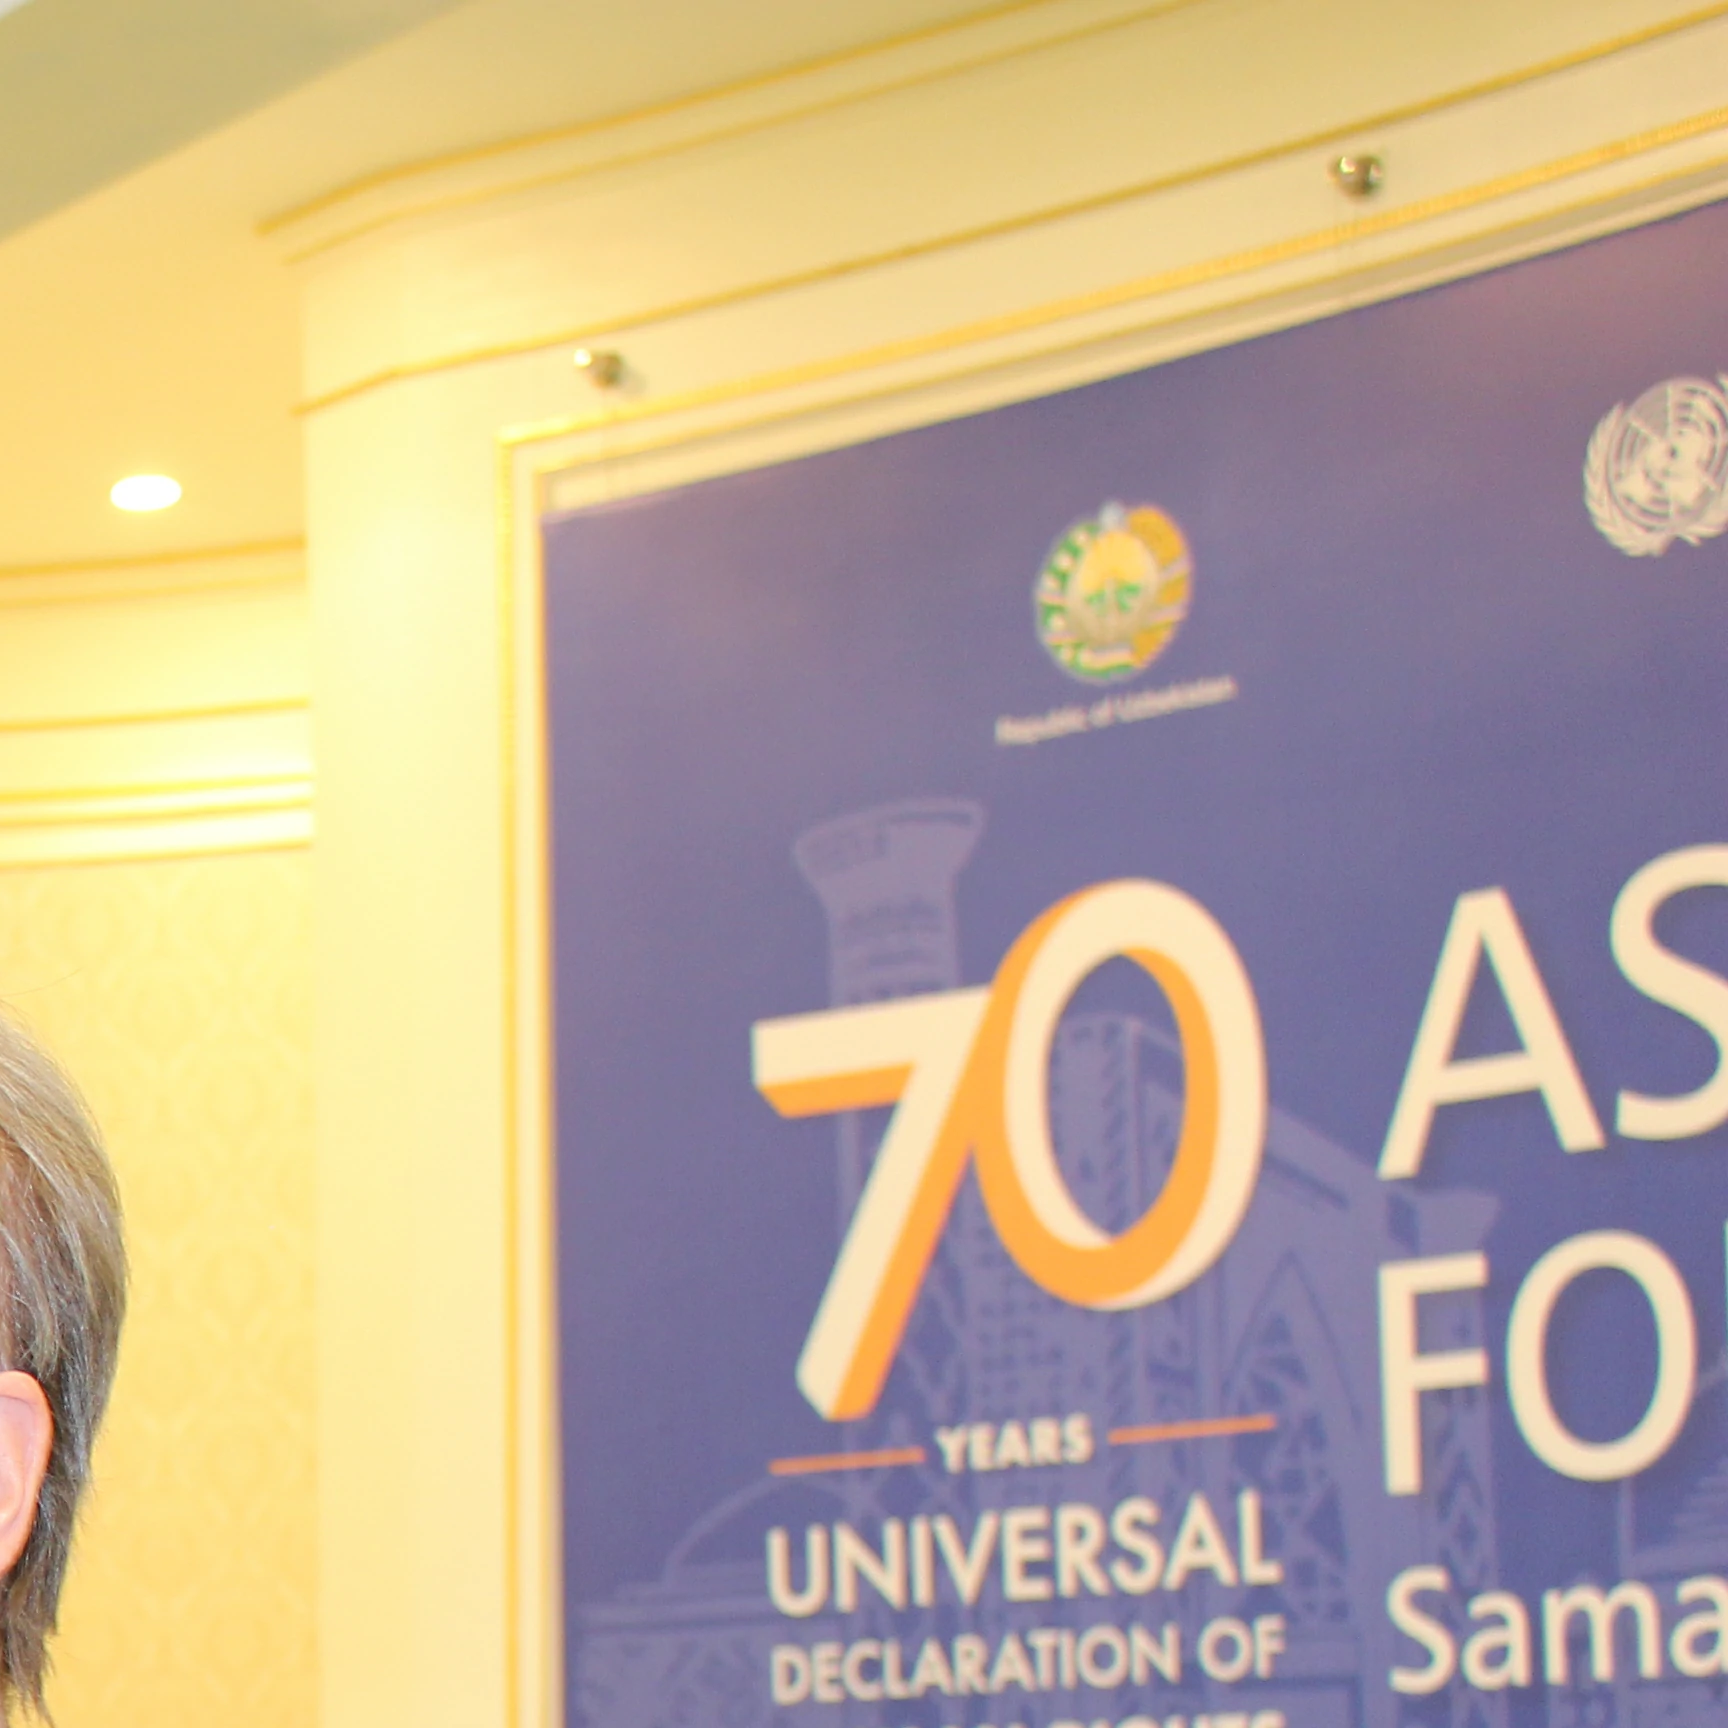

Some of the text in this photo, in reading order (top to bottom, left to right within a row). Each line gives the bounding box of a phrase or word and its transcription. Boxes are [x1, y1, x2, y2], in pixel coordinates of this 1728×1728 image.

[1377, 843, 1728, 1181] AS
[751, 876, 1270, 1422] 70
[1377, 1222, 1728, 1496] FO
[936, 1413, 1094, 1473] YEARS
[766, 1488, 1284, 1617] UNIVERSAL
[770, 1614, 1287, 1706] DECLARATION OF
[1387, 1565, 1728, 1695] Sama
